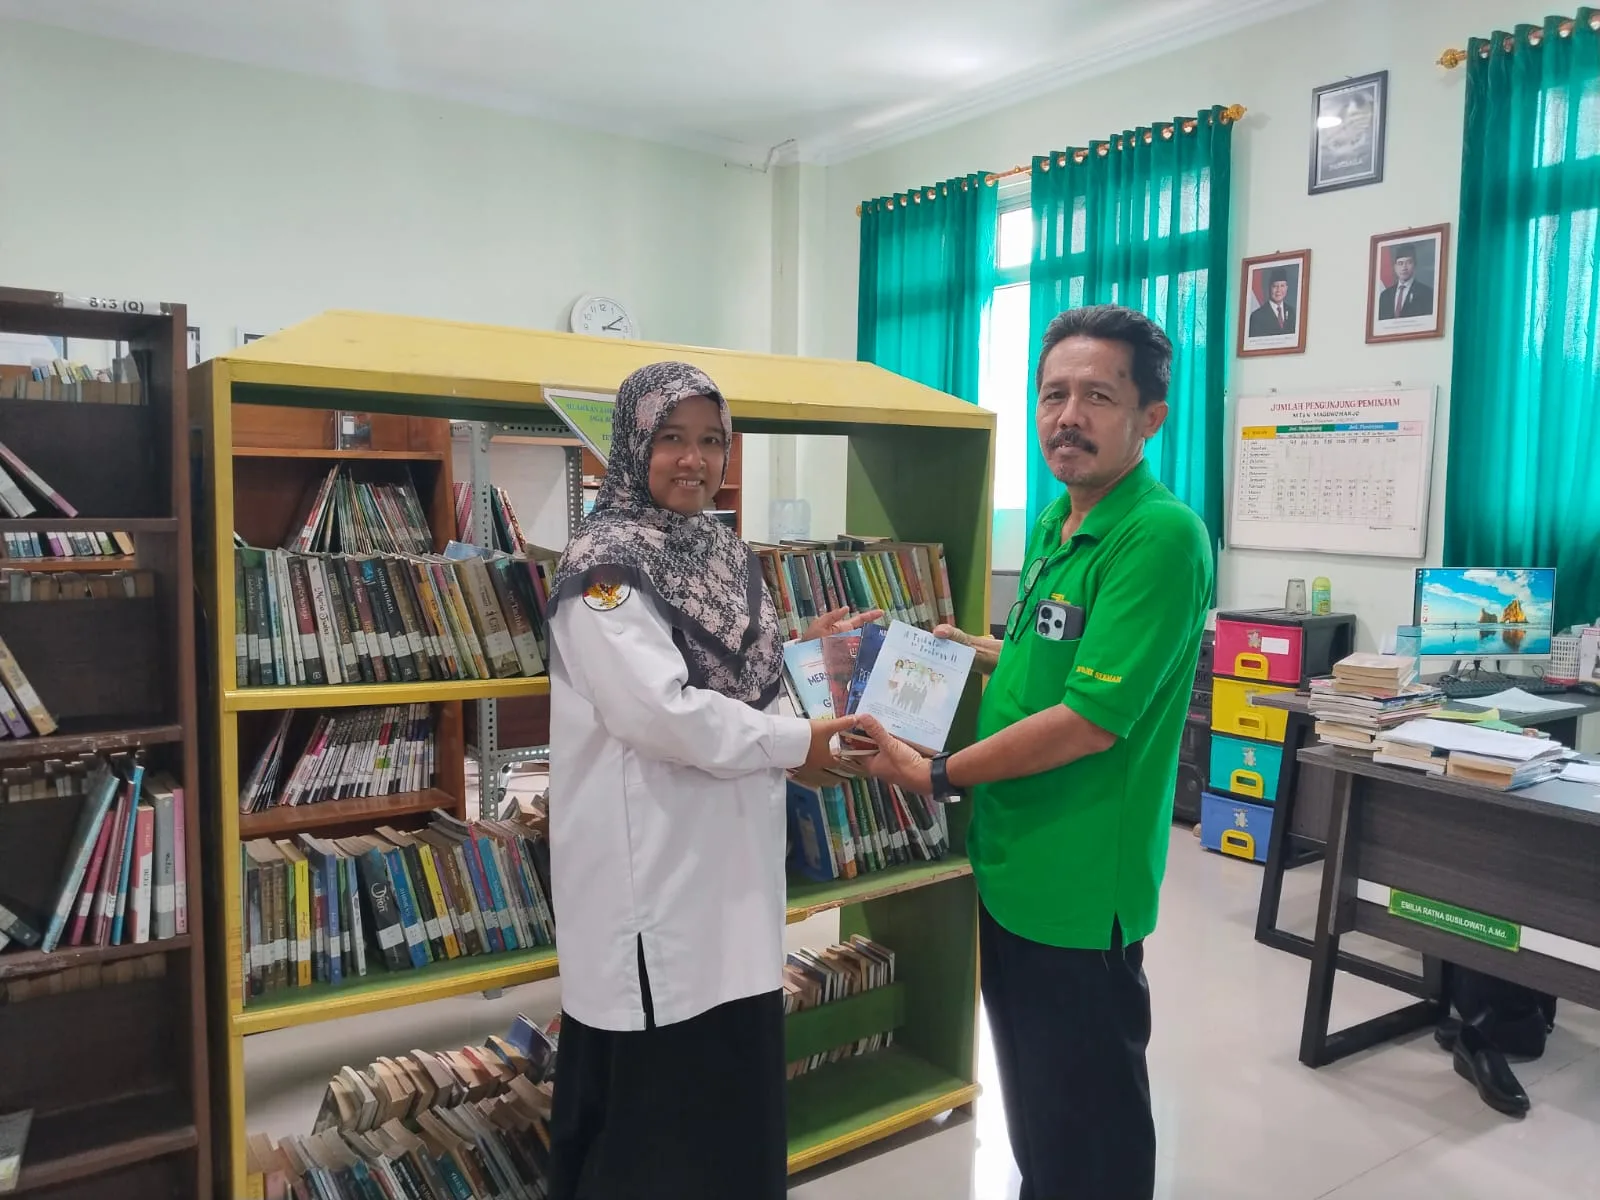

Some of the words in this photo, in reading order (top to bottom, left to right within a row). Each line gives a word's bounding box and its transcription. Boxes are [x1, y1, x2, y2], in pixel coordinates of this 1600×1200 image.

[123, 300, 144, 313] (Q)
[599, 304, 607, 312] 12
[1270, 403, 1303, 411] JUMLAH
[1306, 400, 1356, 409] PENGUNJUNG
[1358, 398, 1400, 407] PEMINJAM
[1401, 901, 1421, 913] EMILIA
[1423, 907, 1444, 920] RATNA
